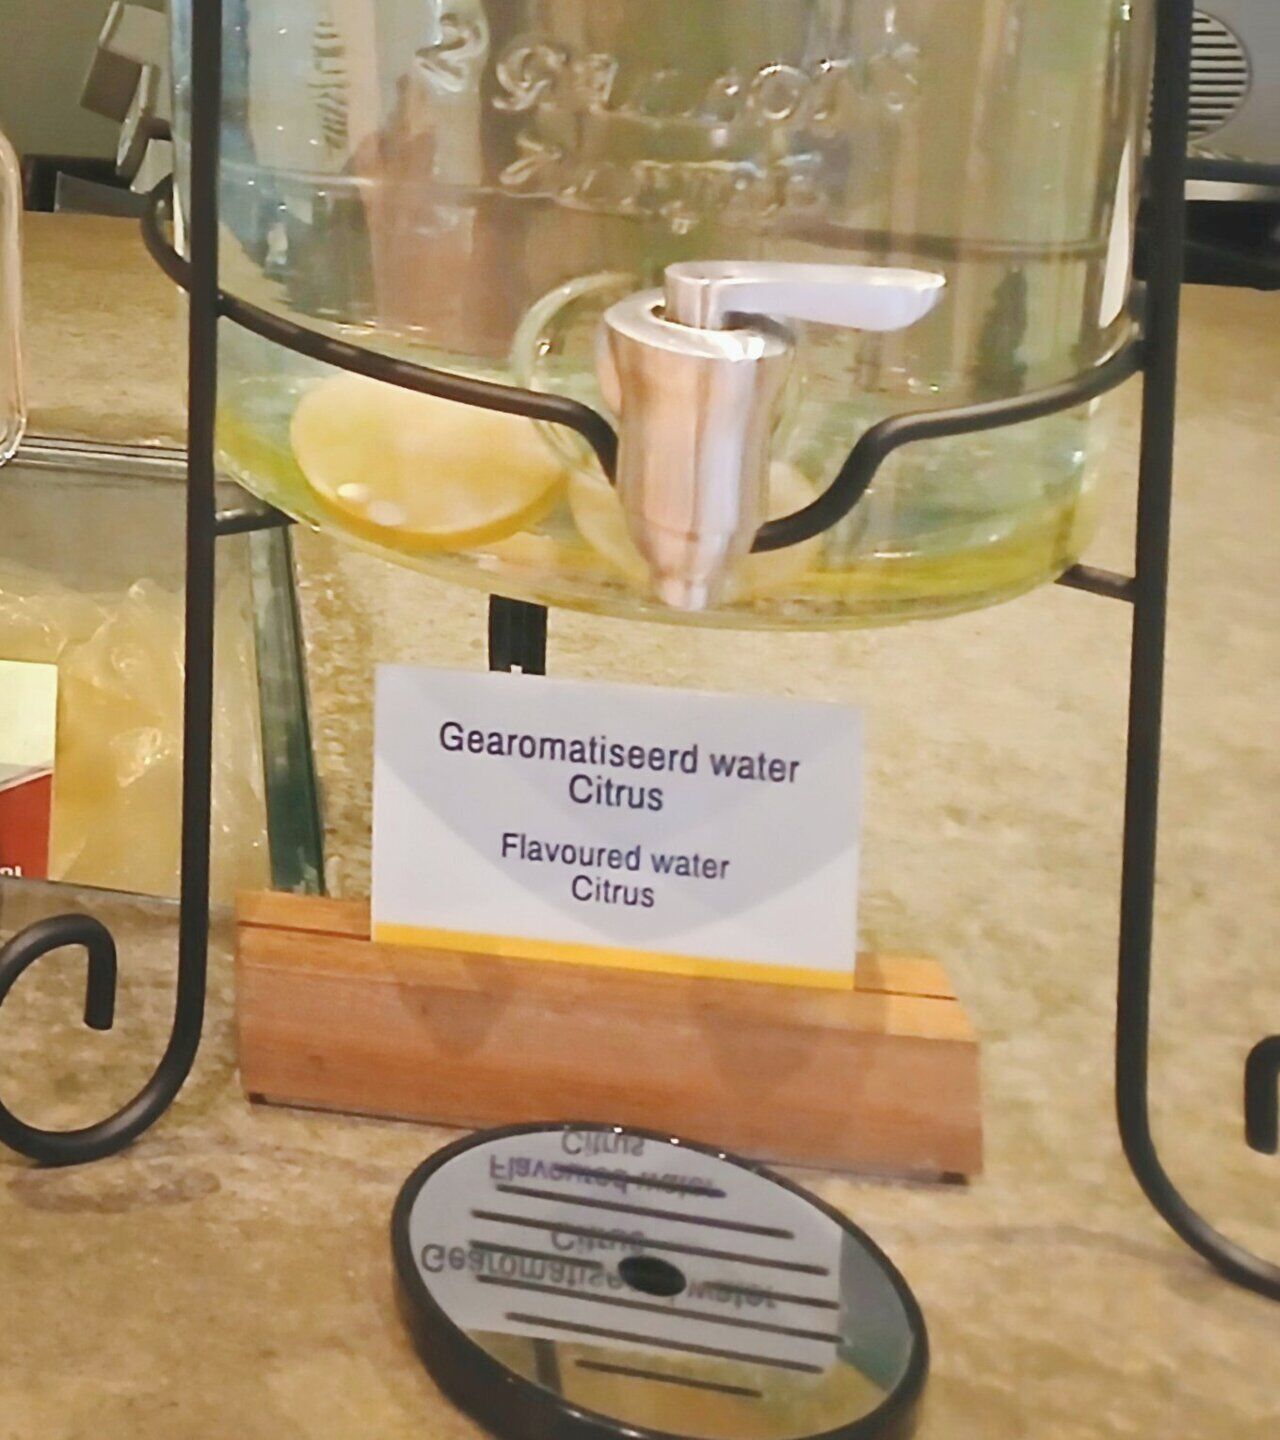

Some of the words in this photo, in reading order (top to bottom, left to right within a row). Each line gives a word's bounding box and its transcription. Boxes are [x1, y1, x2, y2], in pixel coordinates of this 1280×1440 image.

[440, 721, 698, 774] Gearomatiseerd
[711, 754, 800, 783] water
[569, 774, 663, 811] Citrus
[502, 833, 641, 872] Flavoured
[651, 850, 730, 879] water
[571, 875, 654, 908] Citrus
